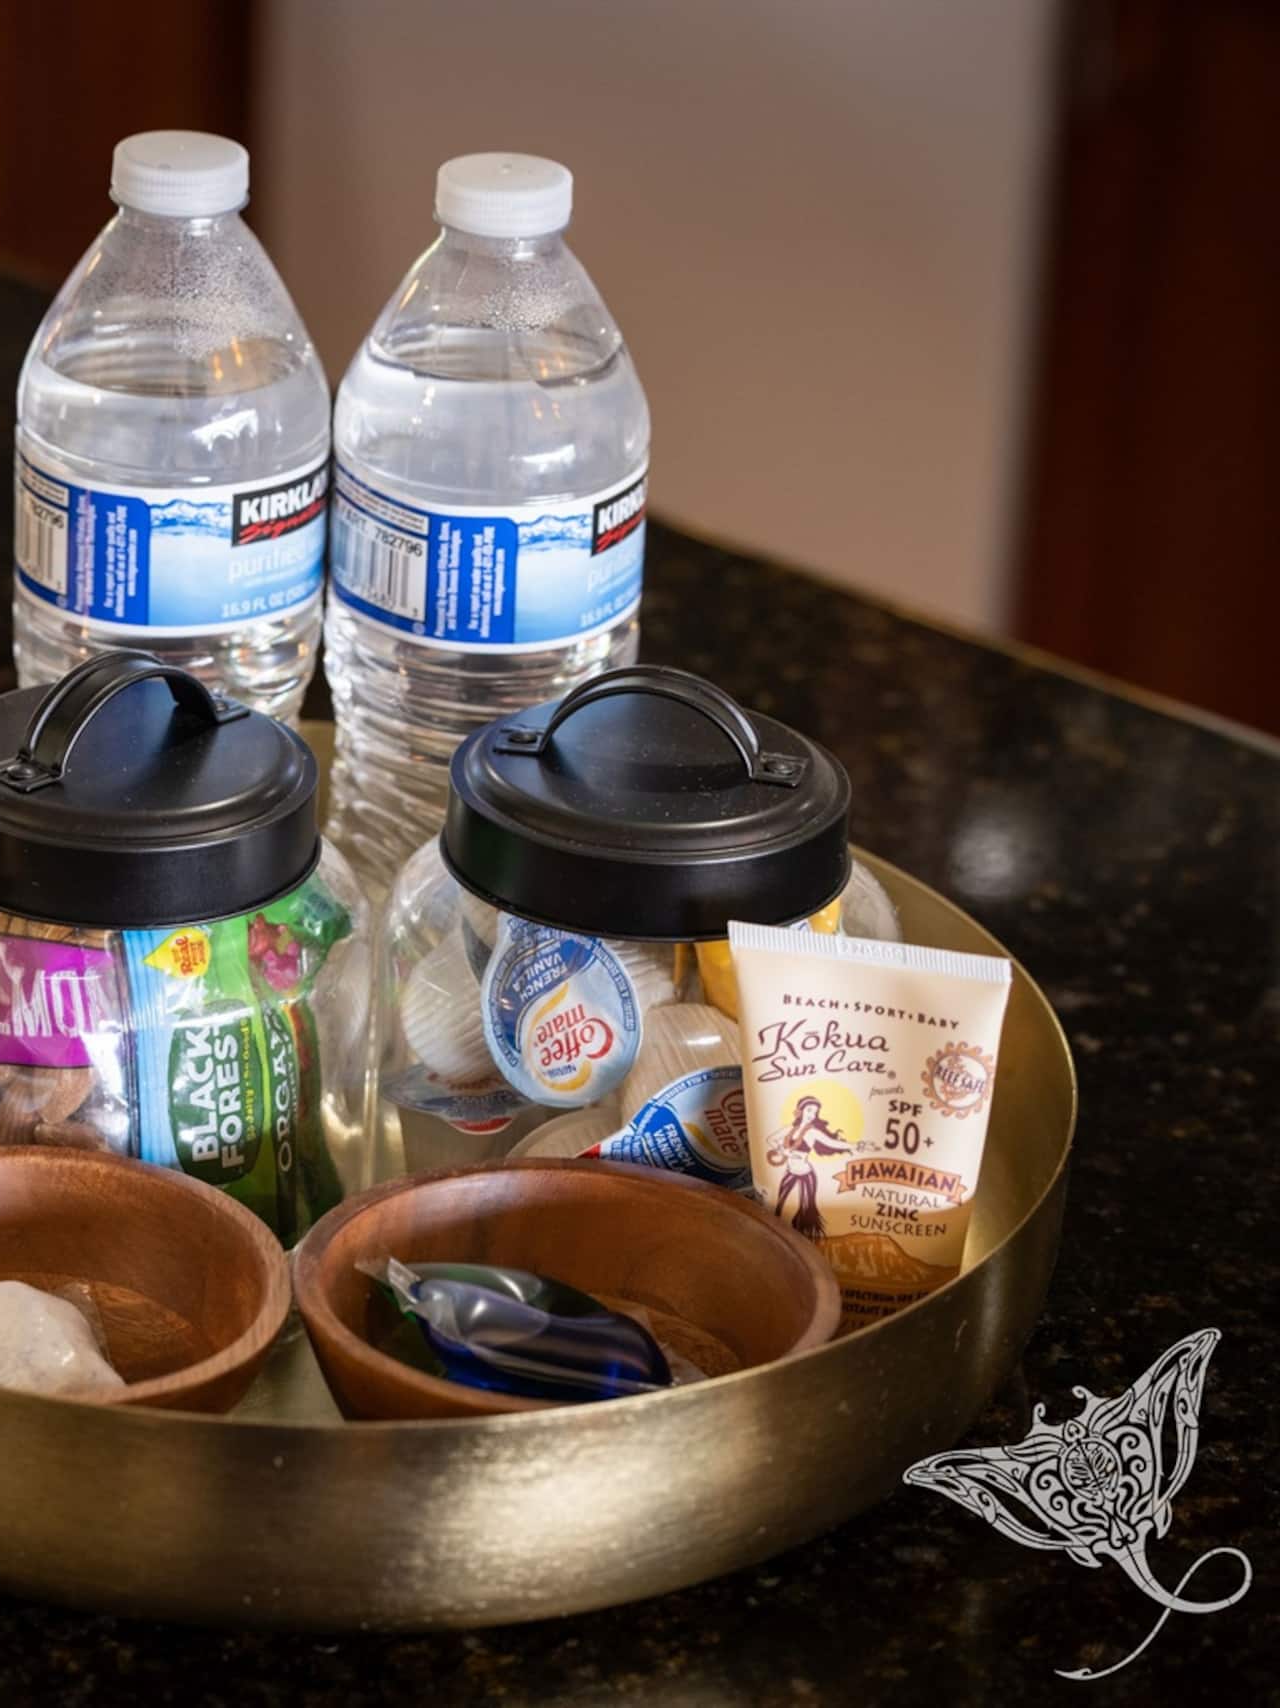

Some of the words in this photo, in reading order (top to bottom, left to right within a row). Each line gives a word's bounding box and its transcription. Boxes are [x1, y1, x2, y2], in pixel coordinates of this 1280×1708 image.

[512, 952, 563, 993] VANILLA
[521, 964, 569, 1003] FRENCH
[536, 1003, 586, 1044] mate
[783, 993, 840, 1009] BEACH
[854, 1002, 905, 1020] SPORT
[917, 1012, 960, 1030] BABY
[539, 1017, 614, 1067] Coffee
[752, 1018, 889, 1063] Kōkua
[757, 1055, 817, 1083] Sun
[824, 1049, 887, 1073] Care
[185, 1025, 219, 1162] BLACK
[887, 1099, 923, 1117] SPF
[662, 1122, 696, 1168] FRENCH
[703, 1109, 742, 1153] mate
[850, 1162, 957, 1193] HAWAIIAN
[861, 1185, 942, 1209] NATURAL
[849, 1214, 947, 1237] SUNSCREEN
[875, 1202, 919, 1222] ZINC
